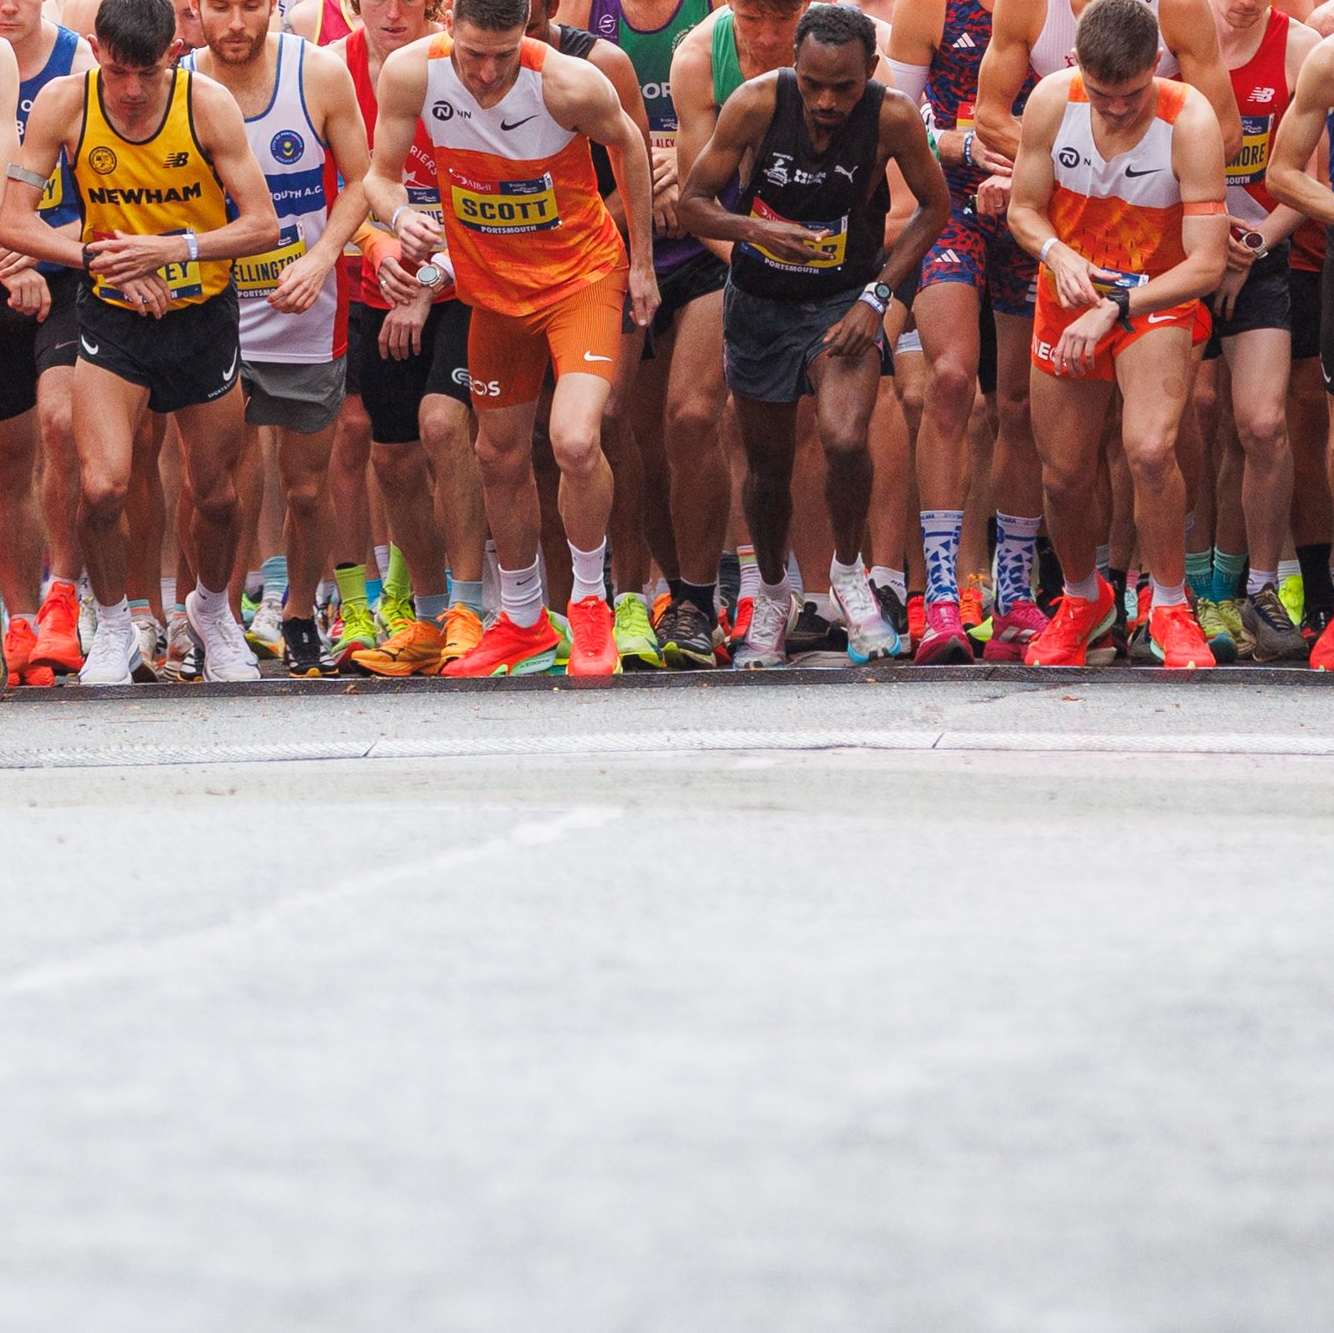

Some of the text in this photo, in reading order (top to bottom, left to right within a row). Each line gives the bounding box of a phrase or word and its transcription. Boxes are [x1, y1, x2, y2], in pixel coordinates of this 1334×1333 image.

[408, 144, 438, 176] RIERS
[87, 181, 202, 206] NEWHAM
[461, 197, 548, 221] SCOTT
[480, 225, 537, 234] PORTSMOUTH
[763, 257, 820, 275] PORTSMOUTH
